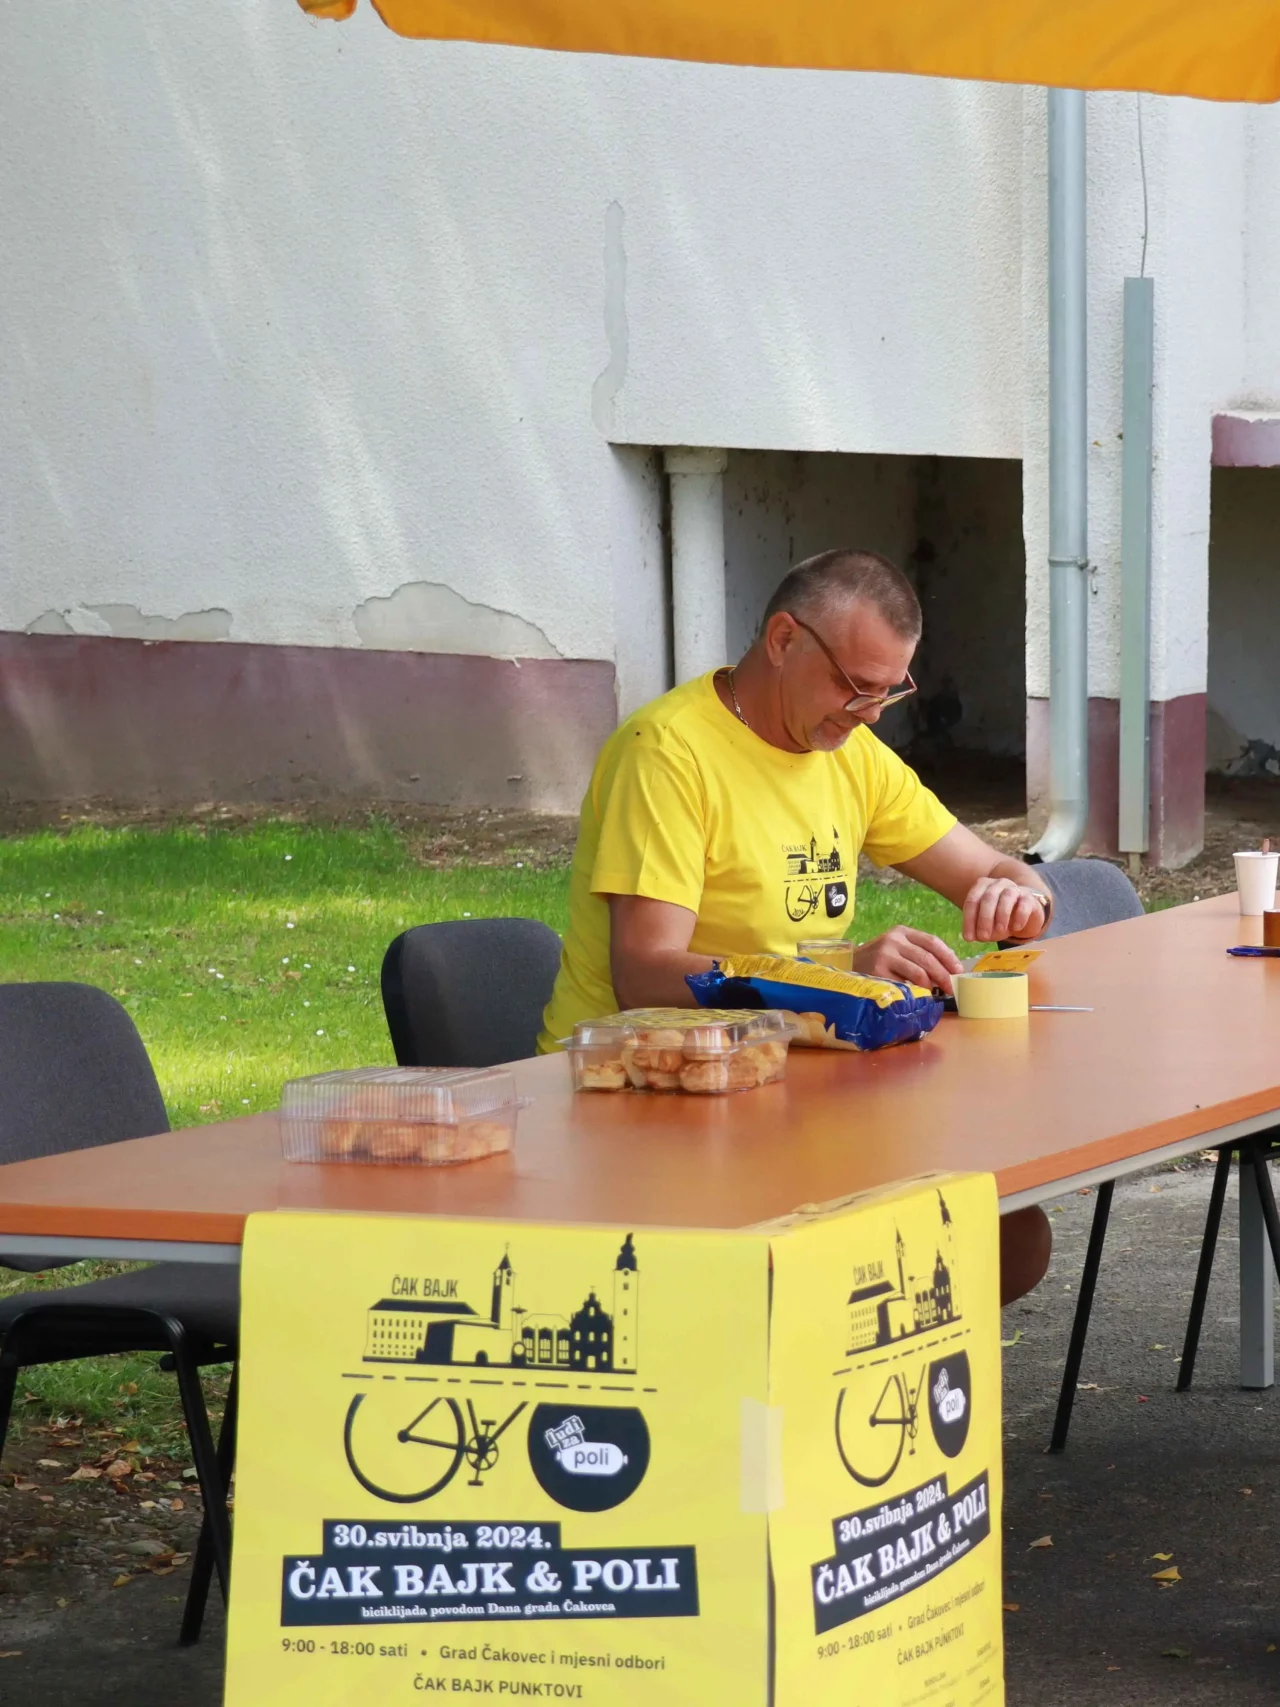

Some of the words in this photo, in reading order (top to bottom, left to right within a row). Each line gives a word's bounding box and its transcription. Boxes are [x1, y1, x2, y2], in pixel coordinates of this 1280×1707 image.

[391, 1274, 418, 1296] ČAK
[423, 1278, 459, 1298] BAJK
[548, 1418, 580, 1444] ludi
[562, 1435, 580, 1449] za
[574, 1448, 609, 1468] poli
[839, 1499, 913, 1543] 30.svibnja
[916, 1481, 946, 1513] 2024.
[334, 1524, 469, 1552] 30.svibnja
[476, 1525, 552, 1549] 2024.
[816, 1552, 876, 1604] ČAK
[877, 1521, 936, 1578] BAJK
[937, 1512, 951, 1544] &
[952, 1483, 988, 1534] POLI
[289, 1560, 384, 1599] ČAK
[393, 1561, 516, 1596] BAJK
[526, 1560, 563, 1592] &
[572, 1557, 681, 1591] POLI
[362, 1604, 428, 1618] biciklijada
[430, 1603, 485, 1618] povodom
[487, 1602, 521, 1614] Dana
[524, 1601, 560, 1615] grada
[563, 1598, 616, 1612] Čakovca
[817, 1640, 840, 1660] 9:00
[847, 1629, 875, 1650] 18:00
[877, 1624, 893, 1641] sati
[907, 1612, 925, 1629] Grad
[281, 1637, 315, 1653] 9:00
[330, 1640, 375, 1656] 18:00
[379, 1642, 408, 1657] sati
[440, 1645, 477, 1660] Grad
[482, 1643, 545, 1664] Čakovec
[559, 1653, 611, 1669] mjesni
[615, 1655, 666, 1671] odbori
[897, 1646, 914, 1666] ČAK
[915, 1638, 934, 1659] BAJK
[413, 1672, 447, 1691] ČAK
[451, 1678, 493, 1693] BAJK
[499, 1680, 583, 1699] PUNKTOVI
